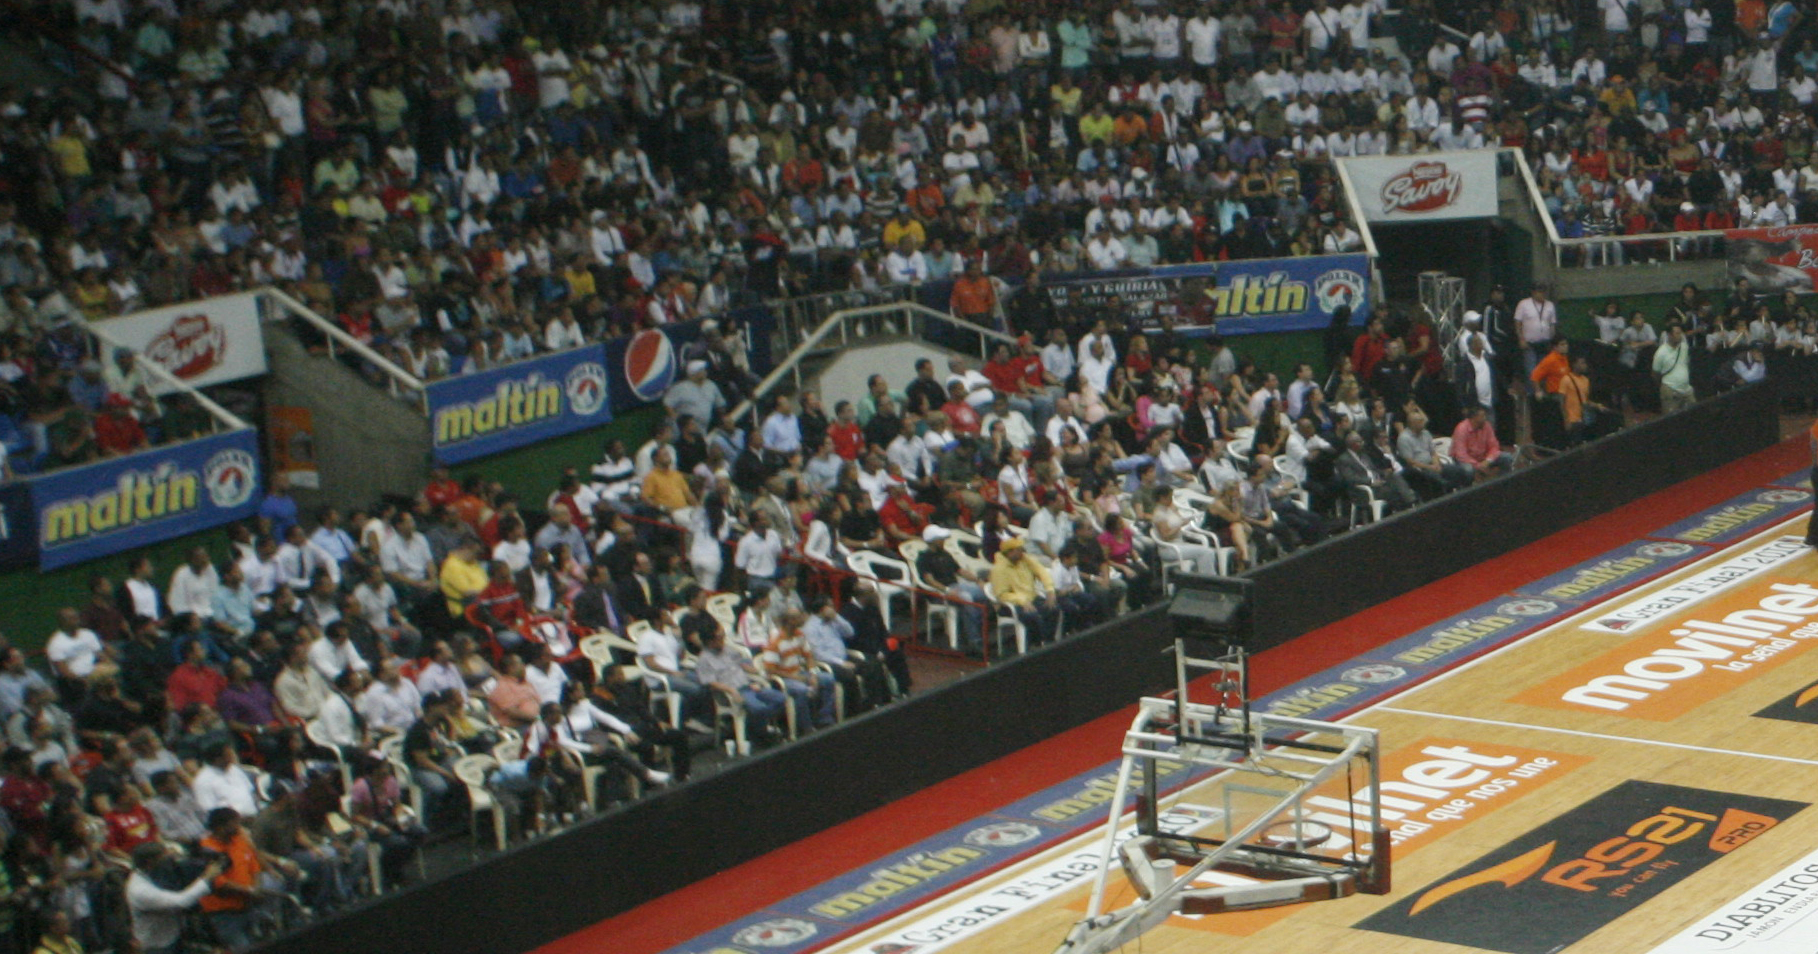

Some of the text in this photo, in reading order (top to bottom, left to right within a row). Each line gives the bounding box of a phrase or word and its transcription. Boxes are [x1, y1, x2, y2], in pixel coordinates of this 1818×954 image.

[1382, 173, 1460, 214] Savoy
[1204, 272, 1311, 317] altín
[42, 463, 199, 546] maltín
[1625, 541, 1806, 621] Gran Final 2010
[1712, 660, 1752, 673] la
[1426, 798, 1475, 822] que
[1466, 777, 1518, 800] nos
[1508, 757, 1558, 779] une
[1542, 806, 1718, 892] RS21
[1718, 820, 1766, 847] PRO
[903, 902, 1006, 947] Gran
[997, 852, 1103, 900] Final
[1747, 916, 1785, 938] JAMON
